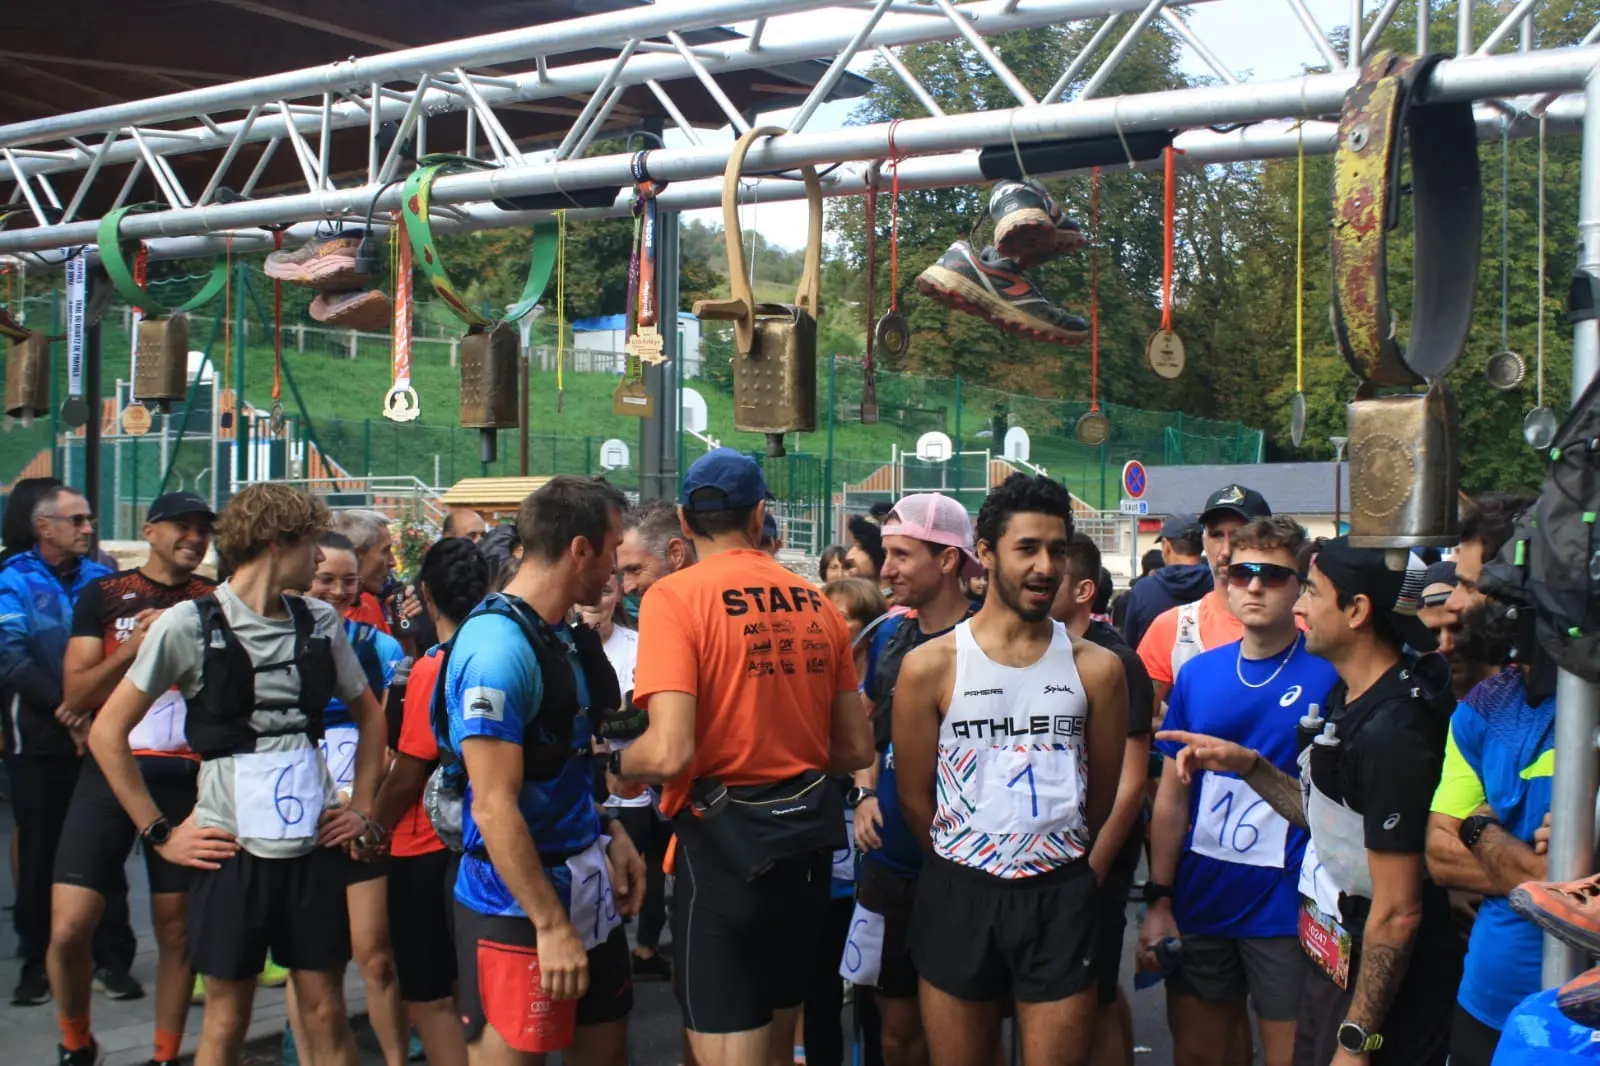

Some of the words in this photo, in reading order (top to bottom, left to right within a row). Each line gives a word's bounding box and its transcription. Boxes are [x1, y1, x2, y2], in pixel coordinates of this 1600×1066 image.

[722, 586, 822, 617] STAFF
[951, 716, 1050, 739] ATHLE
[274, 763, 304, 826] 6
[1007, 763, 1039, 818] 1
[1211, 790, 1266, 854] 16
[1308, 922, 1328, 947] 10247
